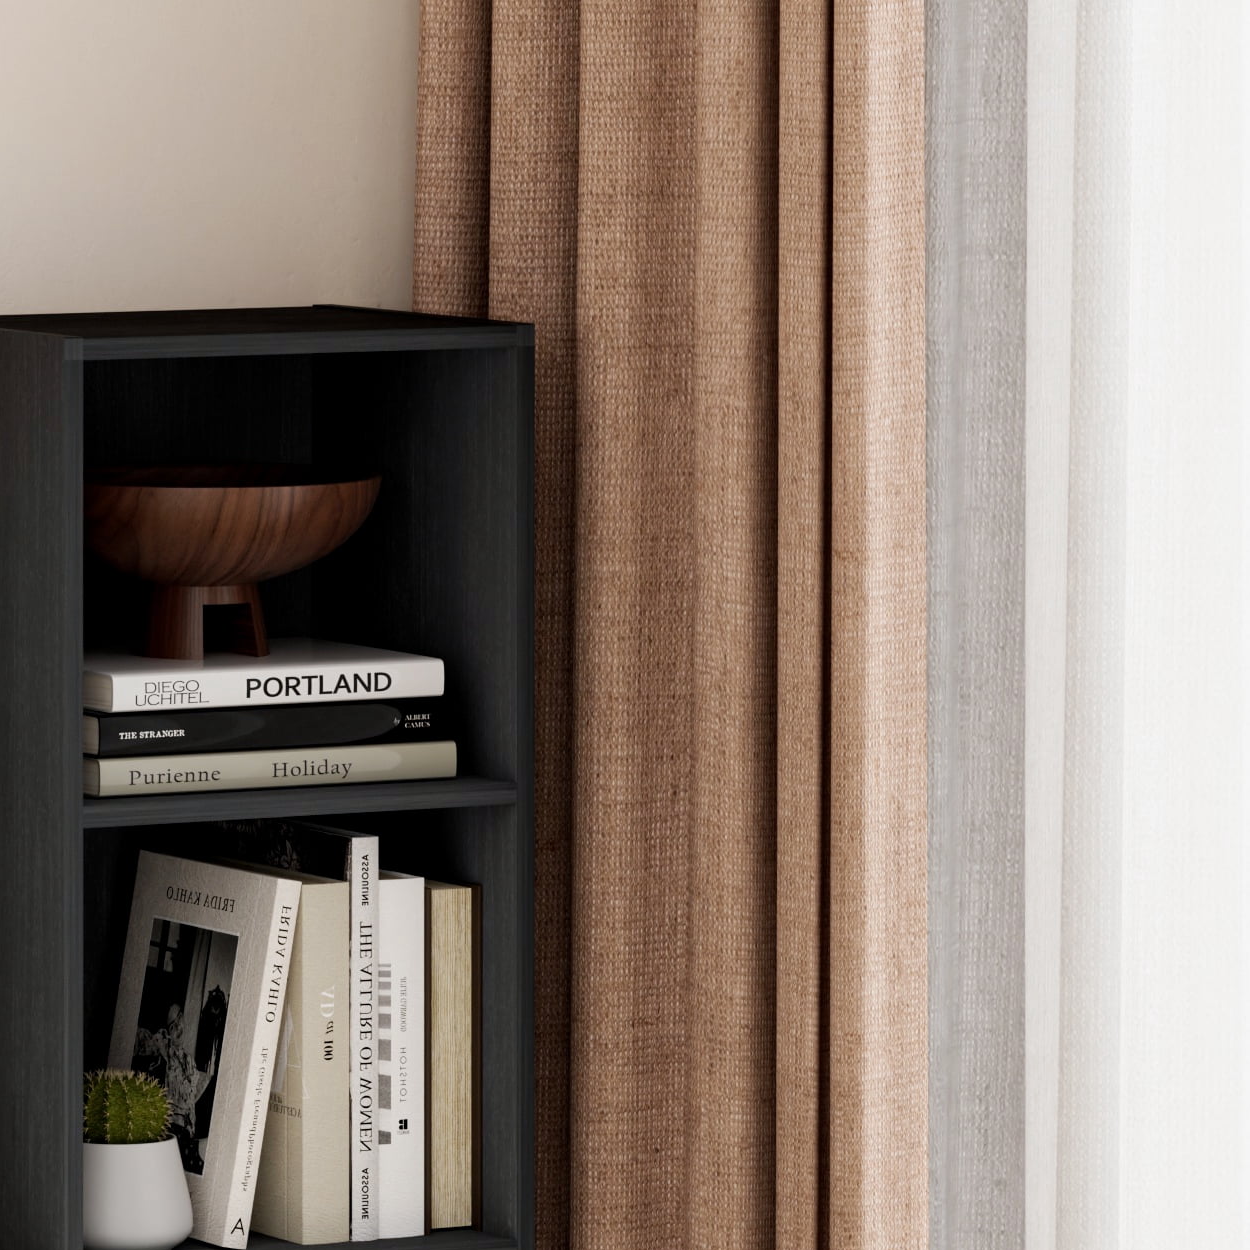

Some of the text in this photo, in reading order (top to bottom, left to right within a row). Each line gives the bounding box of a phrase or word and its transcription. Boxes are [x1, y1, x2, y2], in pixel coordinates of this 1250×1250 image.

[144, 680, 200, 694] DIEGO
[246, 672, 392, 698] PORTLAND
[135, 692, 210, 706] UCHITEL
[404, 713, 430, 721] ALBERT
[118, 729, 185, 740] THE STRANGER
[272, 759, 352, 779] Holiday
[129, 768, 221, 786] Purienne
